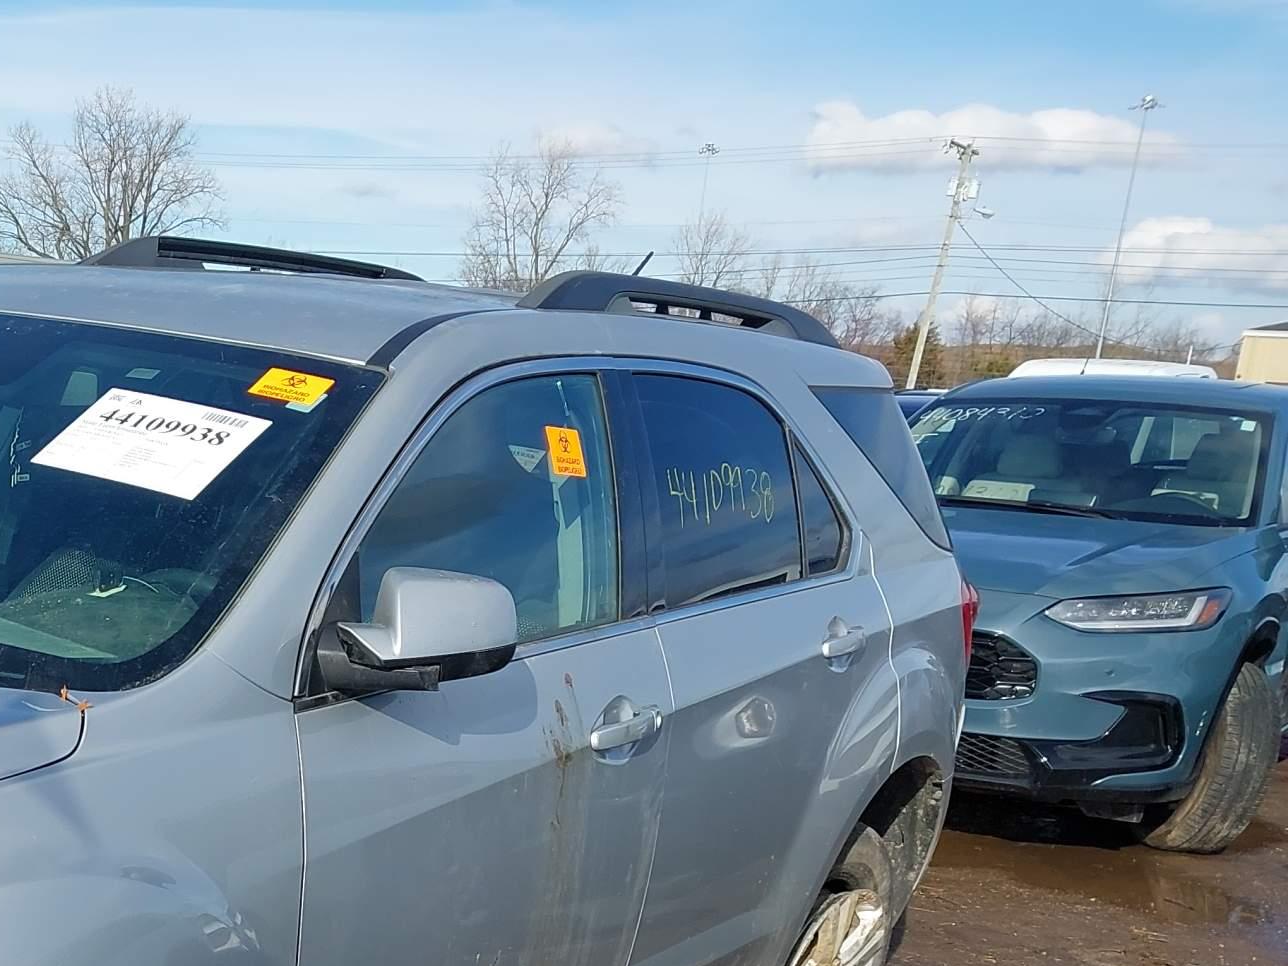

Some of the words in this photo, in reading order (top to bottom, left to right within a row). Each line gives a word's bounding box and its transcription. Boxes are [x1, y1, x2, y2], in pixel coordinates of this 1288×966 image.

[263, 384, 311, 398] BIOHAZARD
[99, 408, 231, 446] 44109938
[666, 462, 775, 528] 44109938
